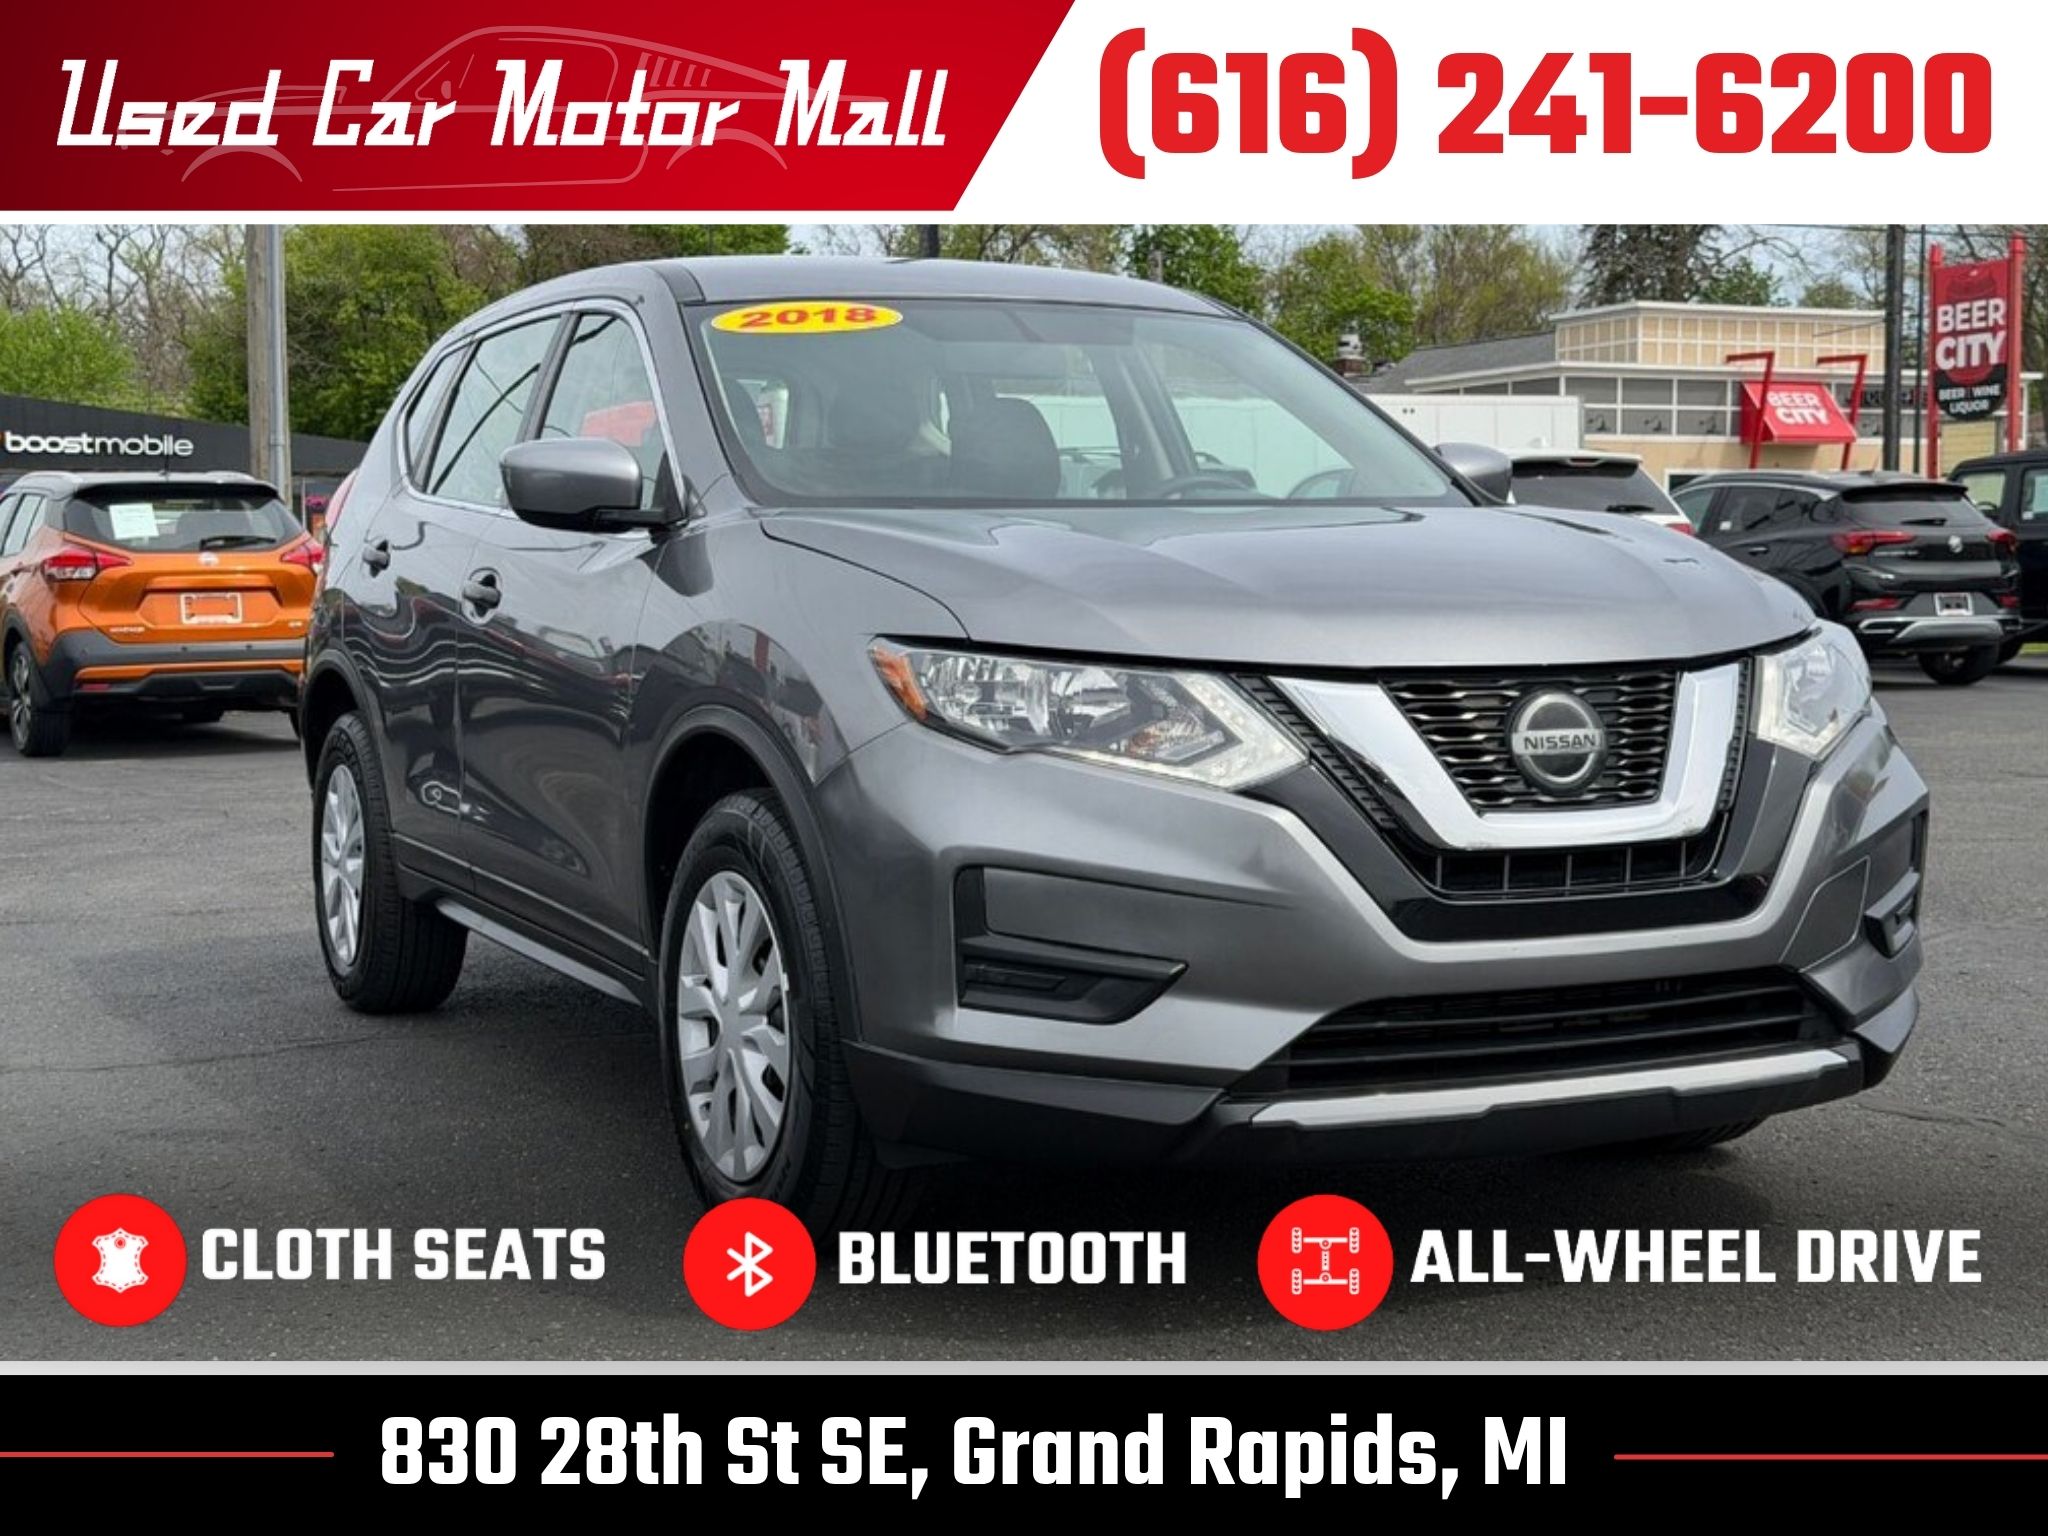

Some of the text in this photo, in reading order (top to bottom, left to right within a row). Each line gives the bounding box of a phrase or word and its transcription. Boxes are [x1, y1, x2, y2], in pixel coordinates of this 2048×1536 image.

[740, 307, 877, 328] 2018
[1936, 298, 2007, 333] BEER
[1935, 331, 2007, 370] CITY
[1766, 391, 1821, 407] BEER
[1938, 384, 2001, 400] BEER WINE
[1775, 407, 1830, 425] CITY
[1949, 400, 1989, 415] LIQUOR
[1524, 734, 1596, 750] NISSAN
